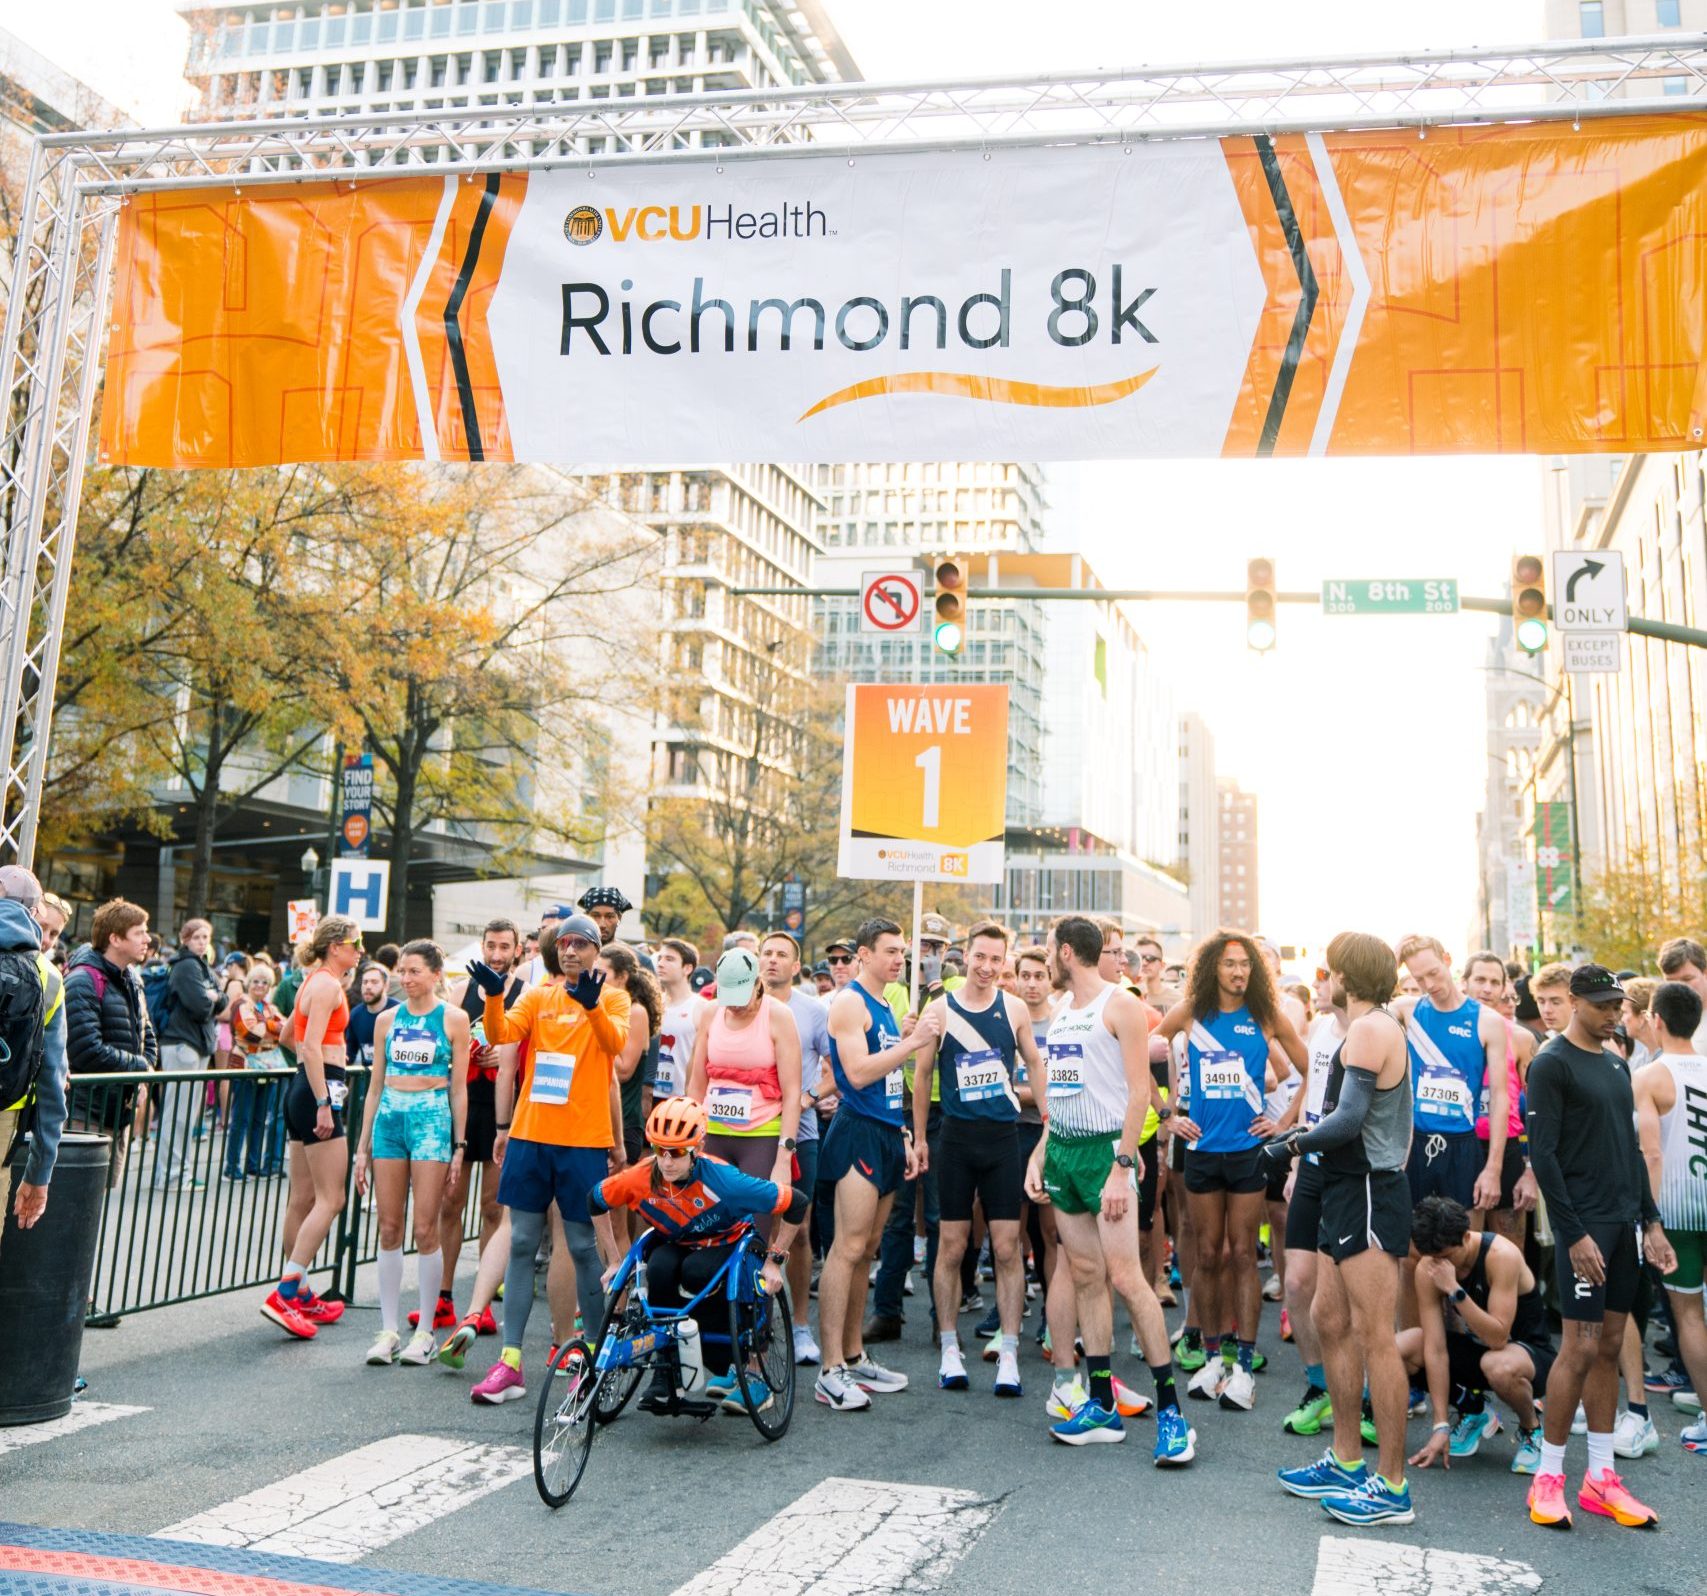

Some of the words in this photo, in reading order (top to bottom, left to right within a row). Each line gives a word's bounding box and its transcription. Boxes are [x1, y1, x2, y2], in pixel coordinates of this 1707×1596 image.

[560, 268, 1012, 356] Richmond
[1047, 264, 1160, 347] 8k
[1329, 581, 1353, 600] N.
[1368, 581, 1409, 600] 8th
[1424, 580, 1451, 600] St
[1329, 602, 1356, 613] 300
[1425, 601, 1453, 612] 200
[1565, 608, 1616, 624] ONLY
[1568, 640, 1616, 651] EXCEPT
[1572, 655, 1613, 666] BUSES
[887, 698, 972, 734] WAVE
[344, 769, 372, 786] FIND
[344, 785, 371, 799] YOUR
[915, 745, 941, 828] 1
[344, 799, 370, 811] STORY
[888, 862, 936, 873] Richmond
[943, 856, 965, 873] 8K
[335, 871, 382, 919] H
[1233, 1025, 1256, 1035] GRC
[1448, 1025, 1472, 1038] GRC
[394, 1050, 429, 1063] 36066
[963, 1072, 998, 1087] 33727
[1051, 1069, 1079, 1082] 33825
[1205, 1073, 1240, 1084] 34910
[1422, 1086, 1459, 1102] 37305
[711, 1103, 745, 1117] 33204
